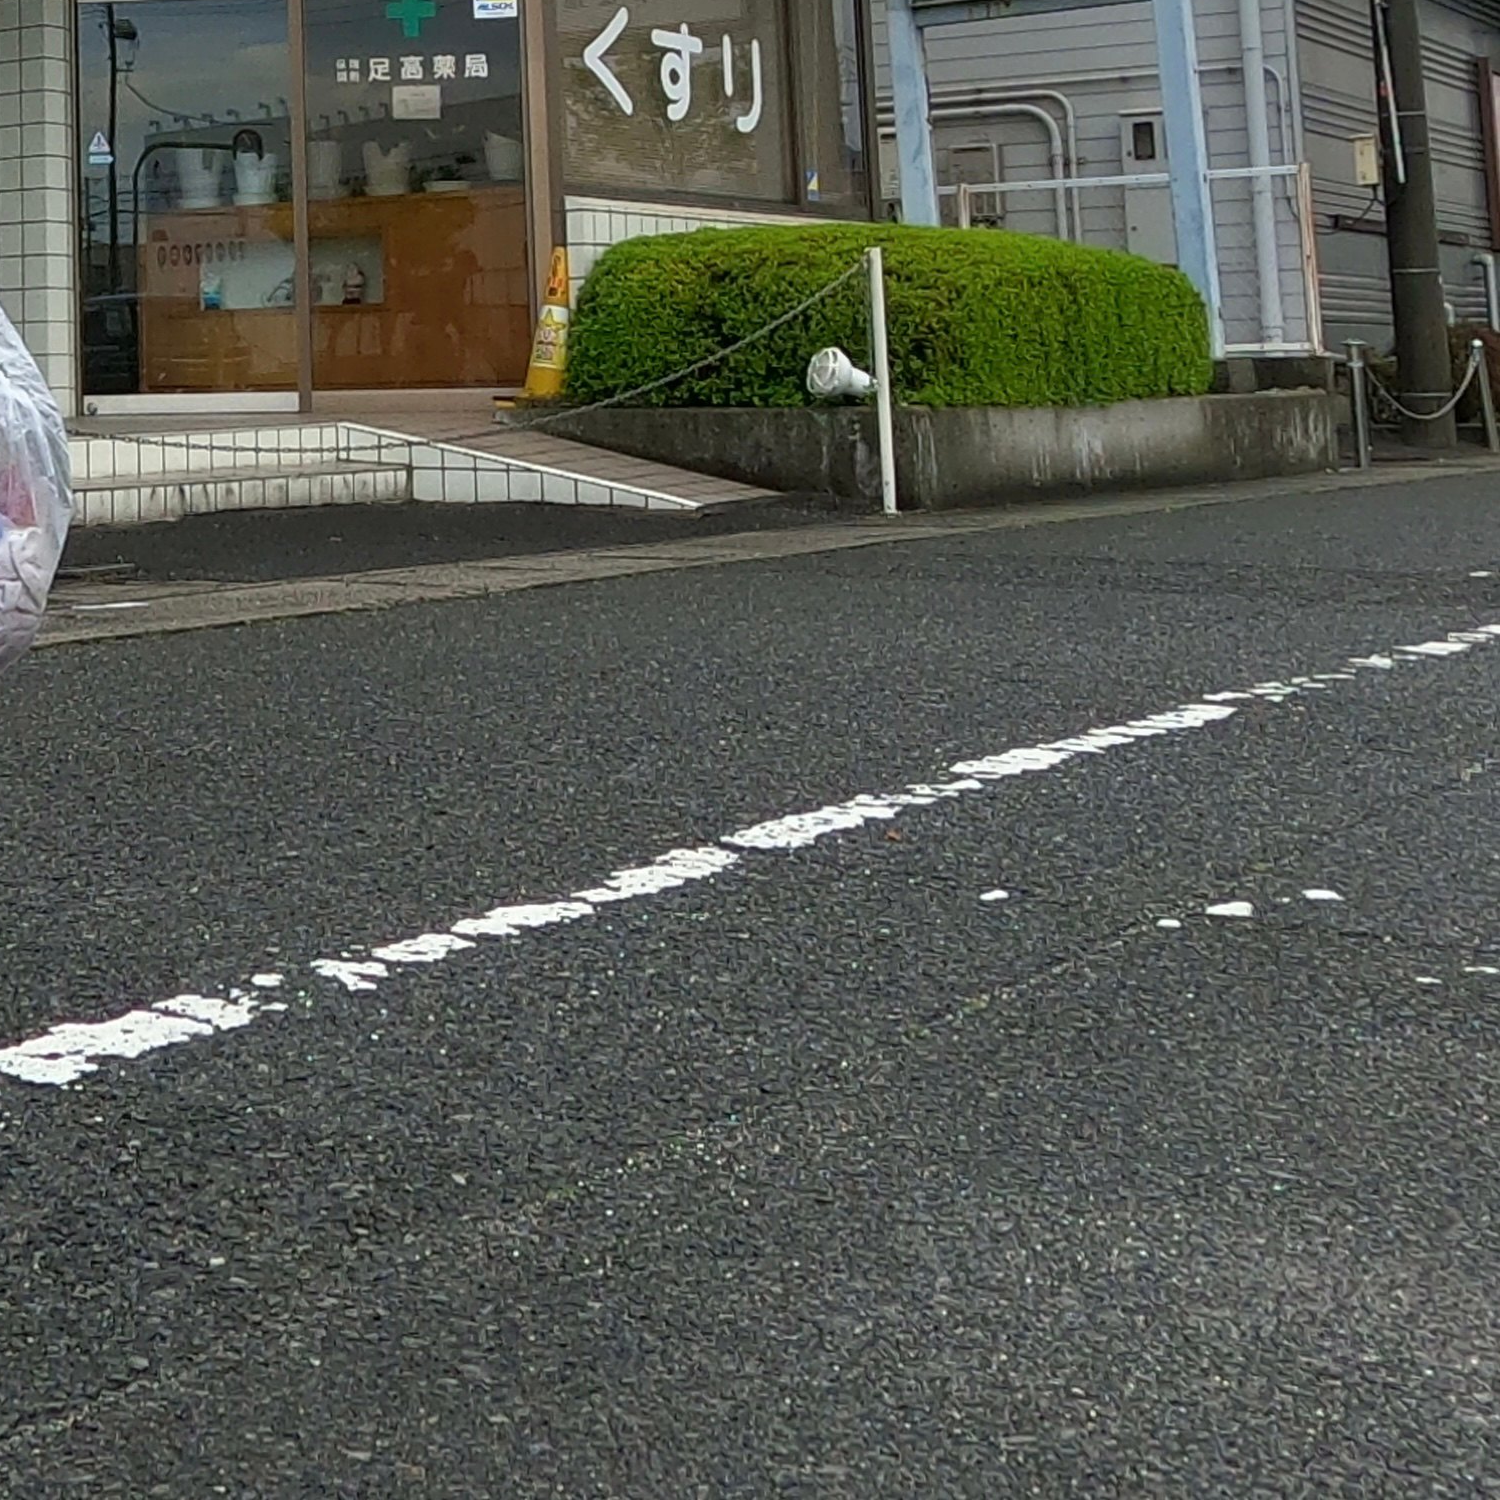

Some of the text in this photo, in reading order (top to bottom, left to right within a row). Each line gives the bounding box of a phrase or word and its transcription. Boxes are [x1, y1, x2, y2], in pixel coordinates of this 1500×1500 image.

[368, 53, 489, 82] 足高薬局
[583, 7, 762, 133] くすり
